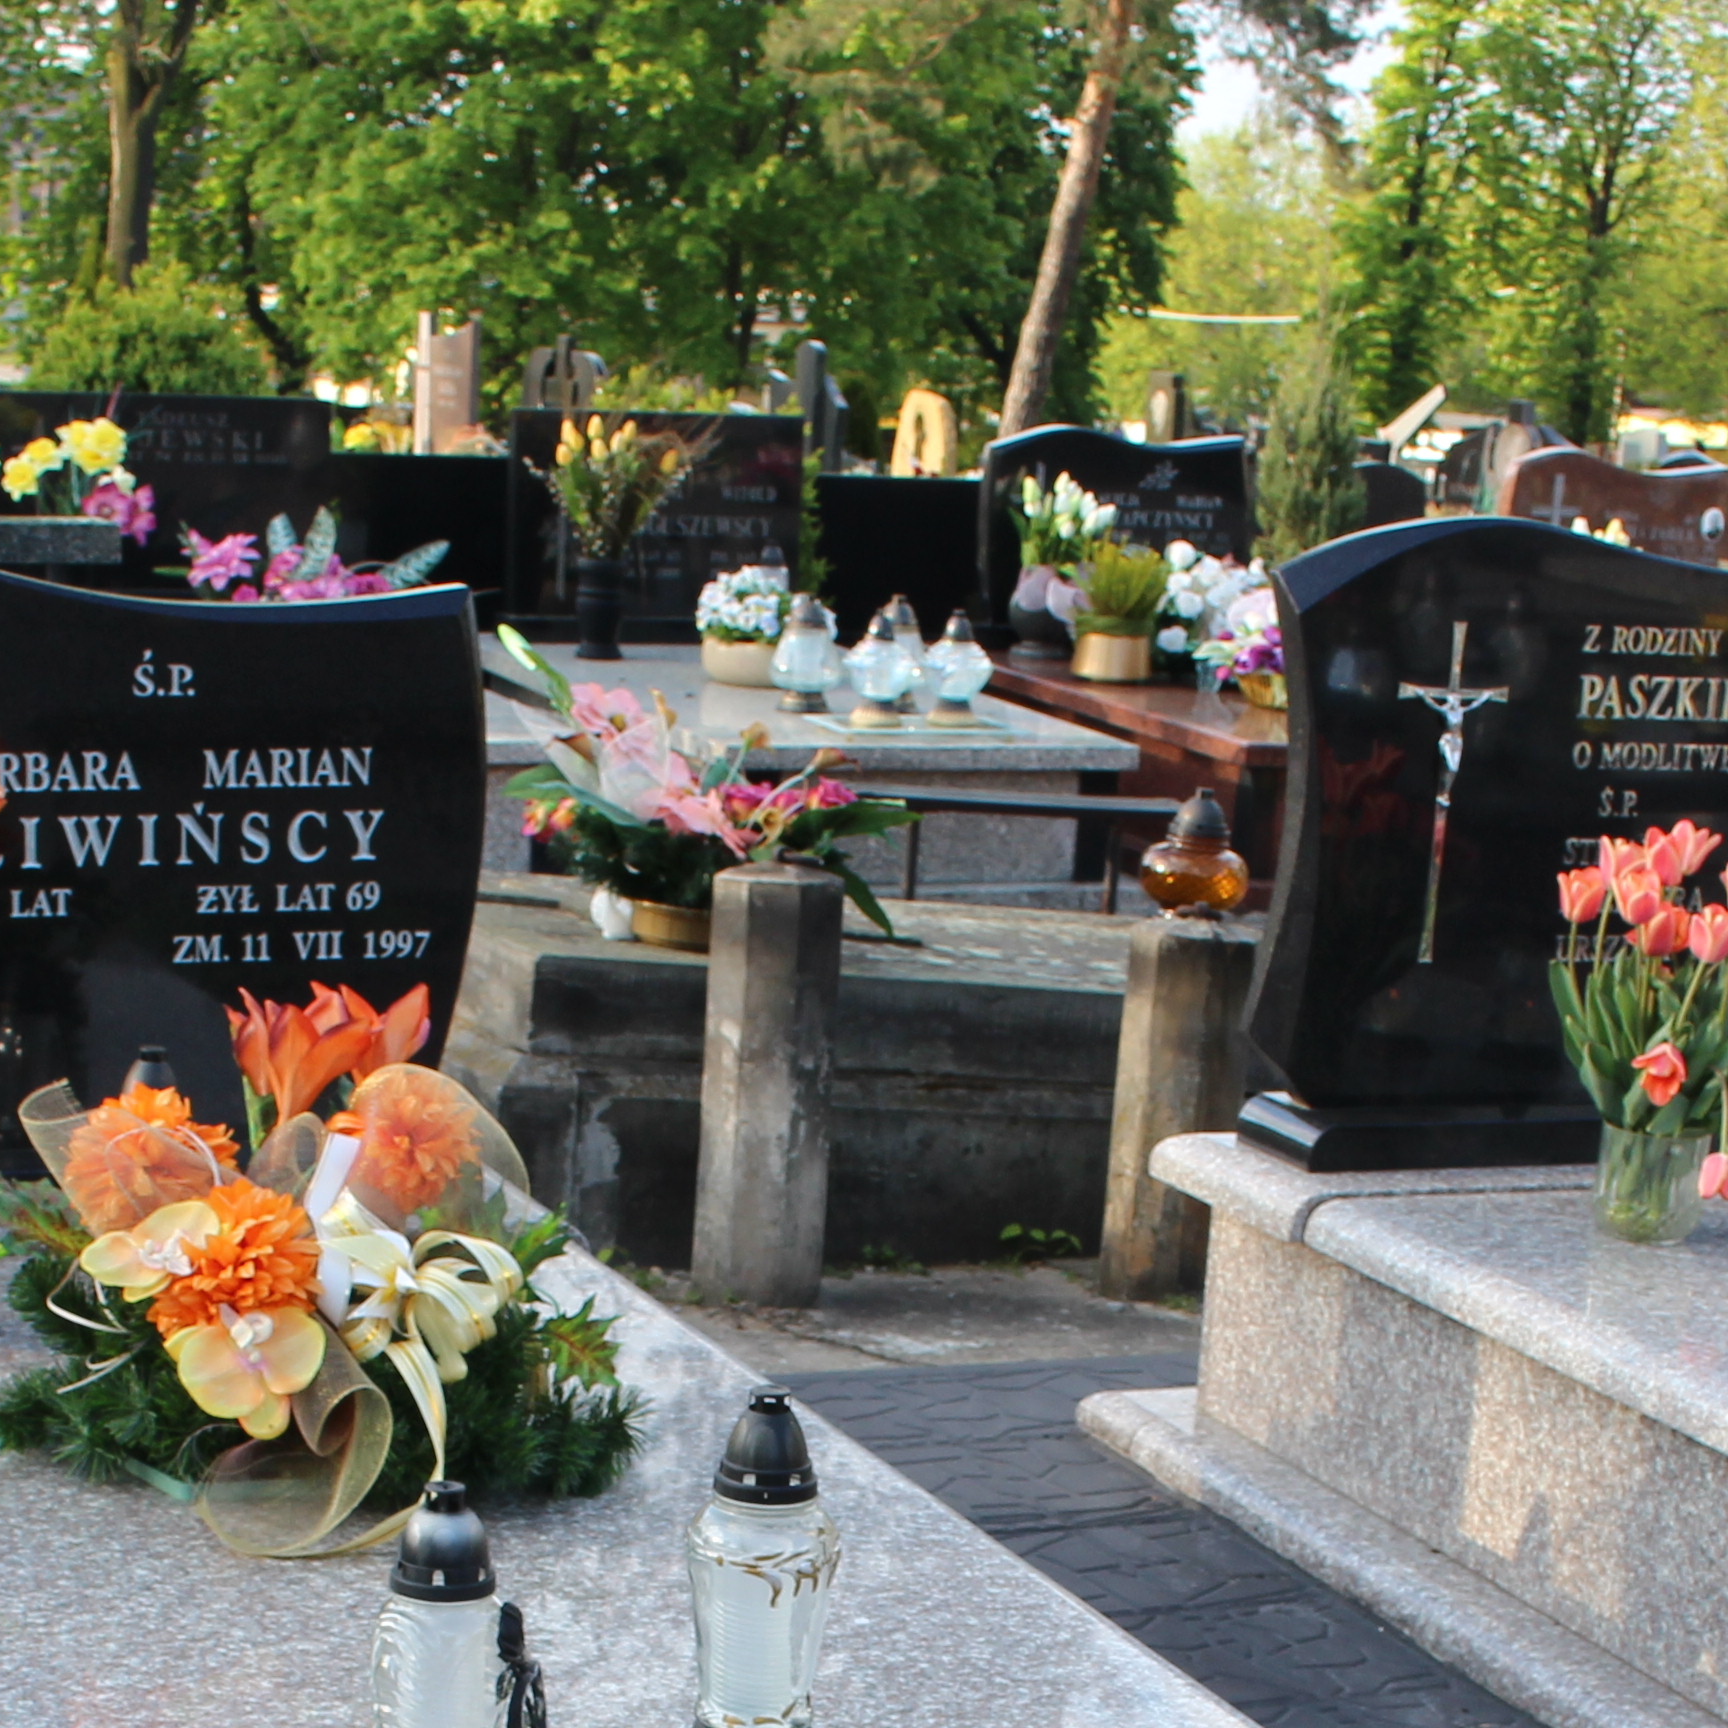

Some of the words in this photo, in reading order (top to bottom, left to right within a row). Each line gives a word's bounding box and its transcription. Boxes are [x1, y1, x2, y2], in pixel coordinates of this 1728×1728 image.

[1582, 624, 1602, 654] Z
[1611, 626, 1725, 657] RODZINY
[131, 647, 197, 698] Ś.P.
[202, 746, 373, 789] MARIAN
[1571, 741, 1592, 770] O
[10, 887, 73, 918] LAT
[275, 882, 335, 912] LAT
[345, 880, 381, 912] 69
[172, 934, 231, 964] ZM.
[240, 932, 271, 963] 11
[292, 930, 343, 960] VII
[362, 929, 432, 960] 1997
